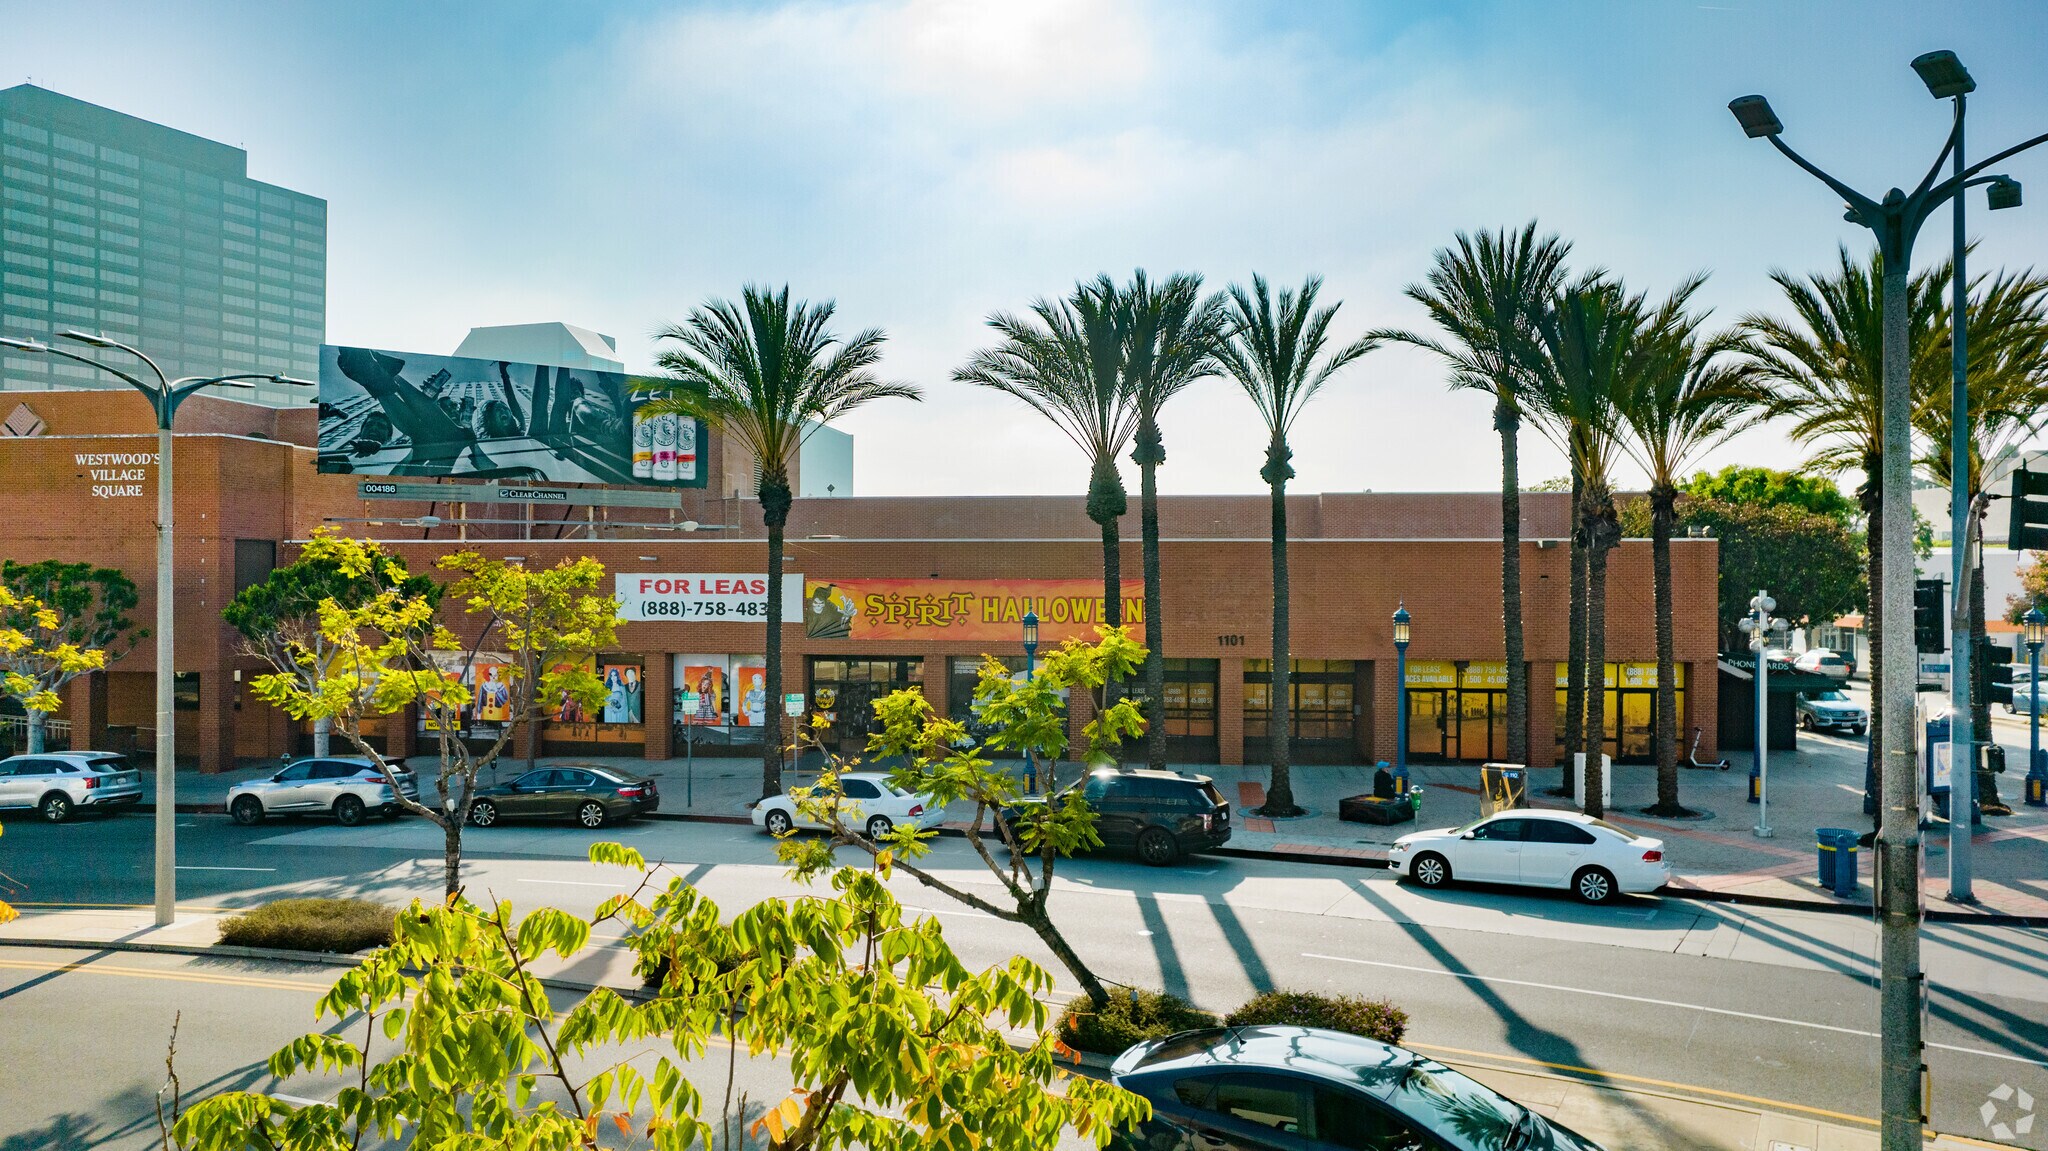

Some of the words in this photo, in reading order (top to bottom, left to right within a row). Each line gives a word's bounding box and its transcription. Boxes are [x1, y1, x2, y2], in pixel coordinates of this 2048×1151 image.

[75, 453, 160, 466] WESTWOOD'S
[90, 469, 146, 481] VILLAGE
[92, 485, 144, 498] SQUARE
[365, 484, 396, 493] 004186
[639, 579, 691, 594] FOR
[699, 579, 766, 595] LEAS
[641, 600, 768, 617] (888)-758-483
[864, 591, 975, 628] SPIRIT
[982, 597, 1145, 624] HALLOWEN
[1217, 635, 1245, 646] 1101
[1727, 659, 1756, 669] PHONE
[1766, 662, 1790, 670] ARDS
